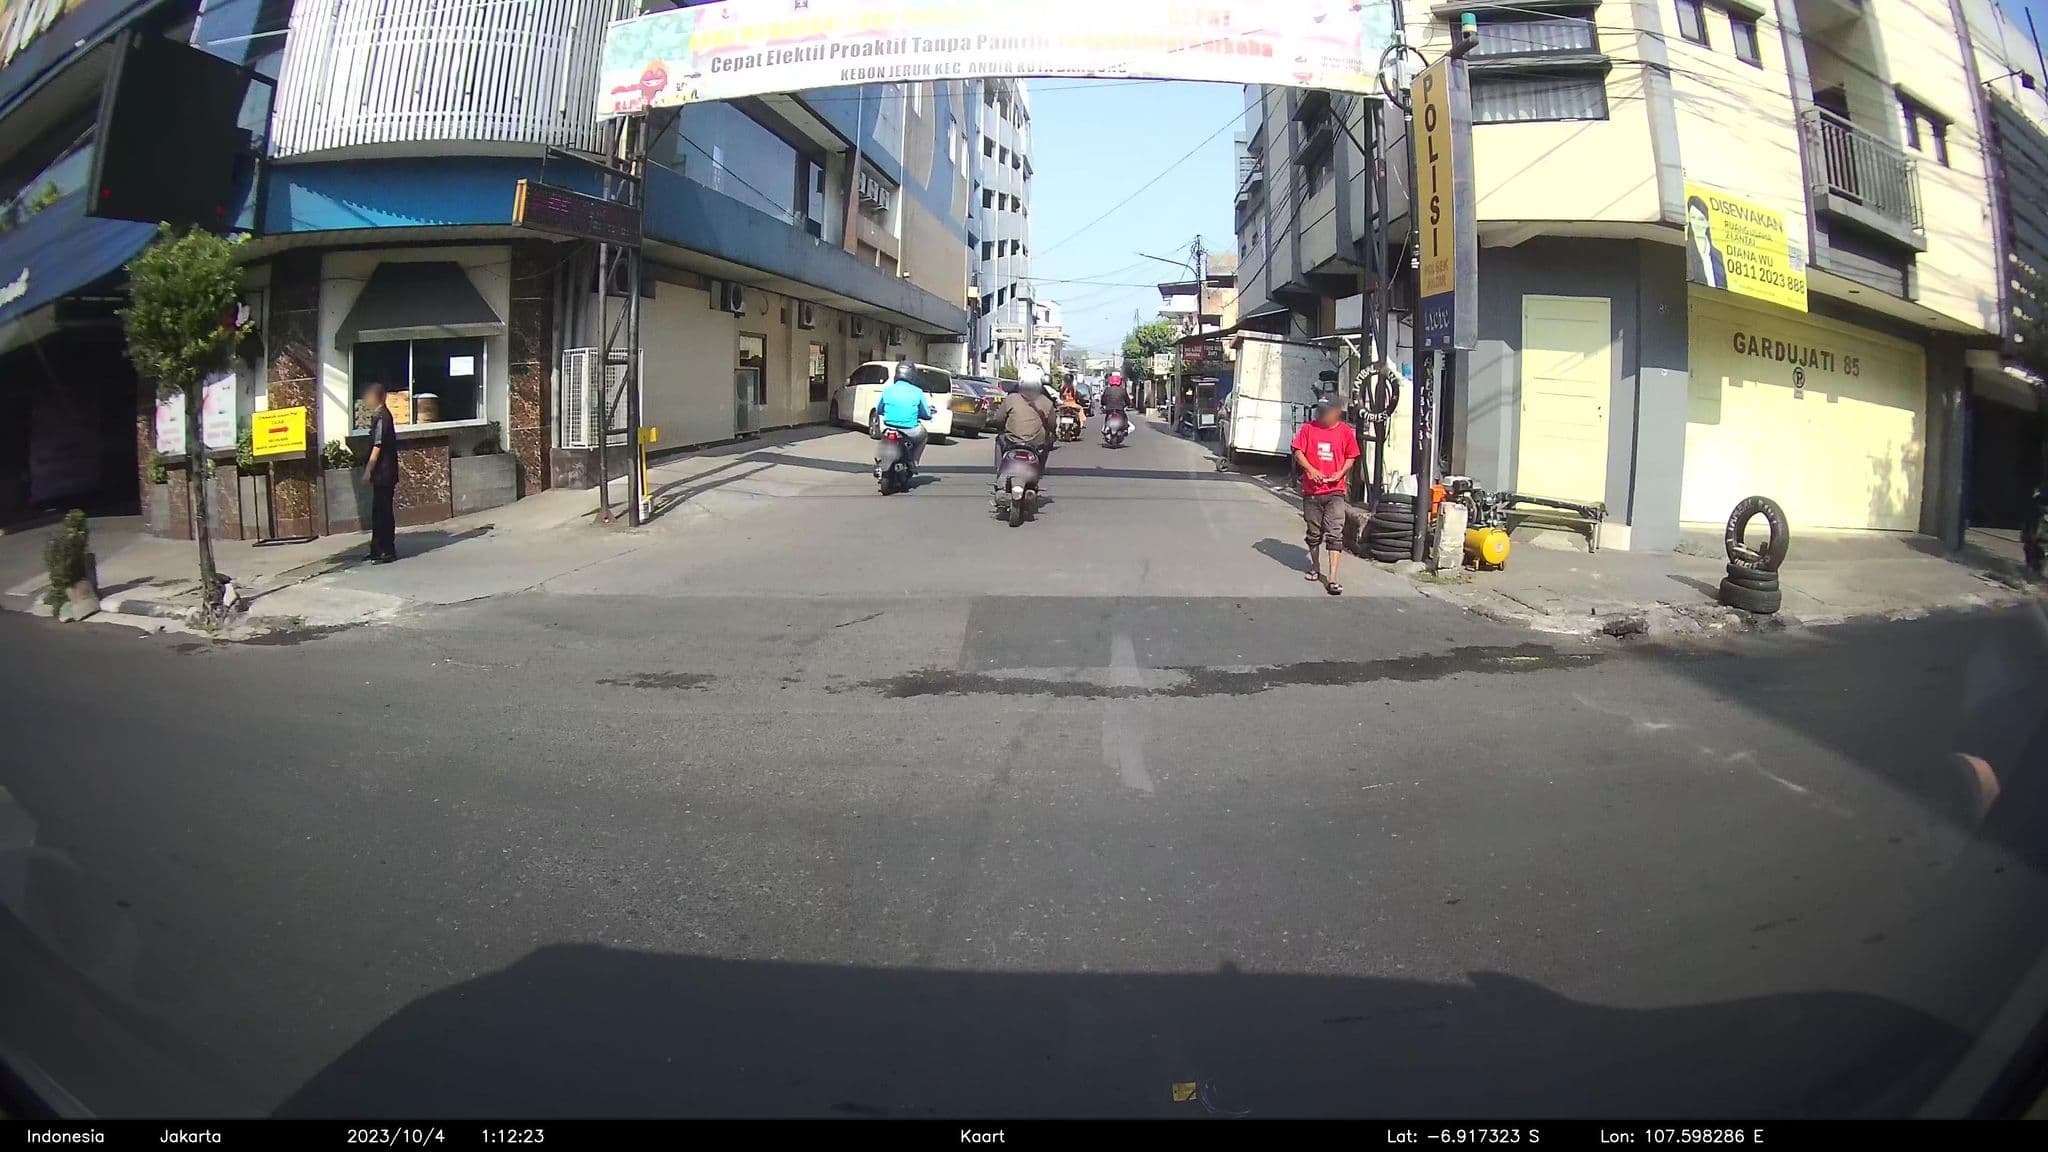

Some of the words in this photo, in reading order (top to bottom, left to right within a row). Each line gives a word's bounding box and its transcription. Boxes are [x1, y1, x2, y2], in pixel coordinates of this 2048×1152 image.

[711, 53, 762, 73] Cepat
[766, 44, 826, 66] Efektif
[829, 38, 907, 59] Proaktif
[911, 36, 972, 54] Tanpa
[840, 66, 885, 81] KEBON
[888, 63, 931, 78] JERUK
[1422, 74, 1441, 257] POLISI
[1709, 197, 1784, 233] DISEWAKAN
[1726, 244, 1758, 263] DIANA
[1758, 254, 1774, 267] WU
[1727, 258, 1757, 280] 0811
[1759, 267, 1786, 289] 2023
[1733, 331, 1835, 373] GARDUJATI
[1843, 355, 1861, 378] 85
